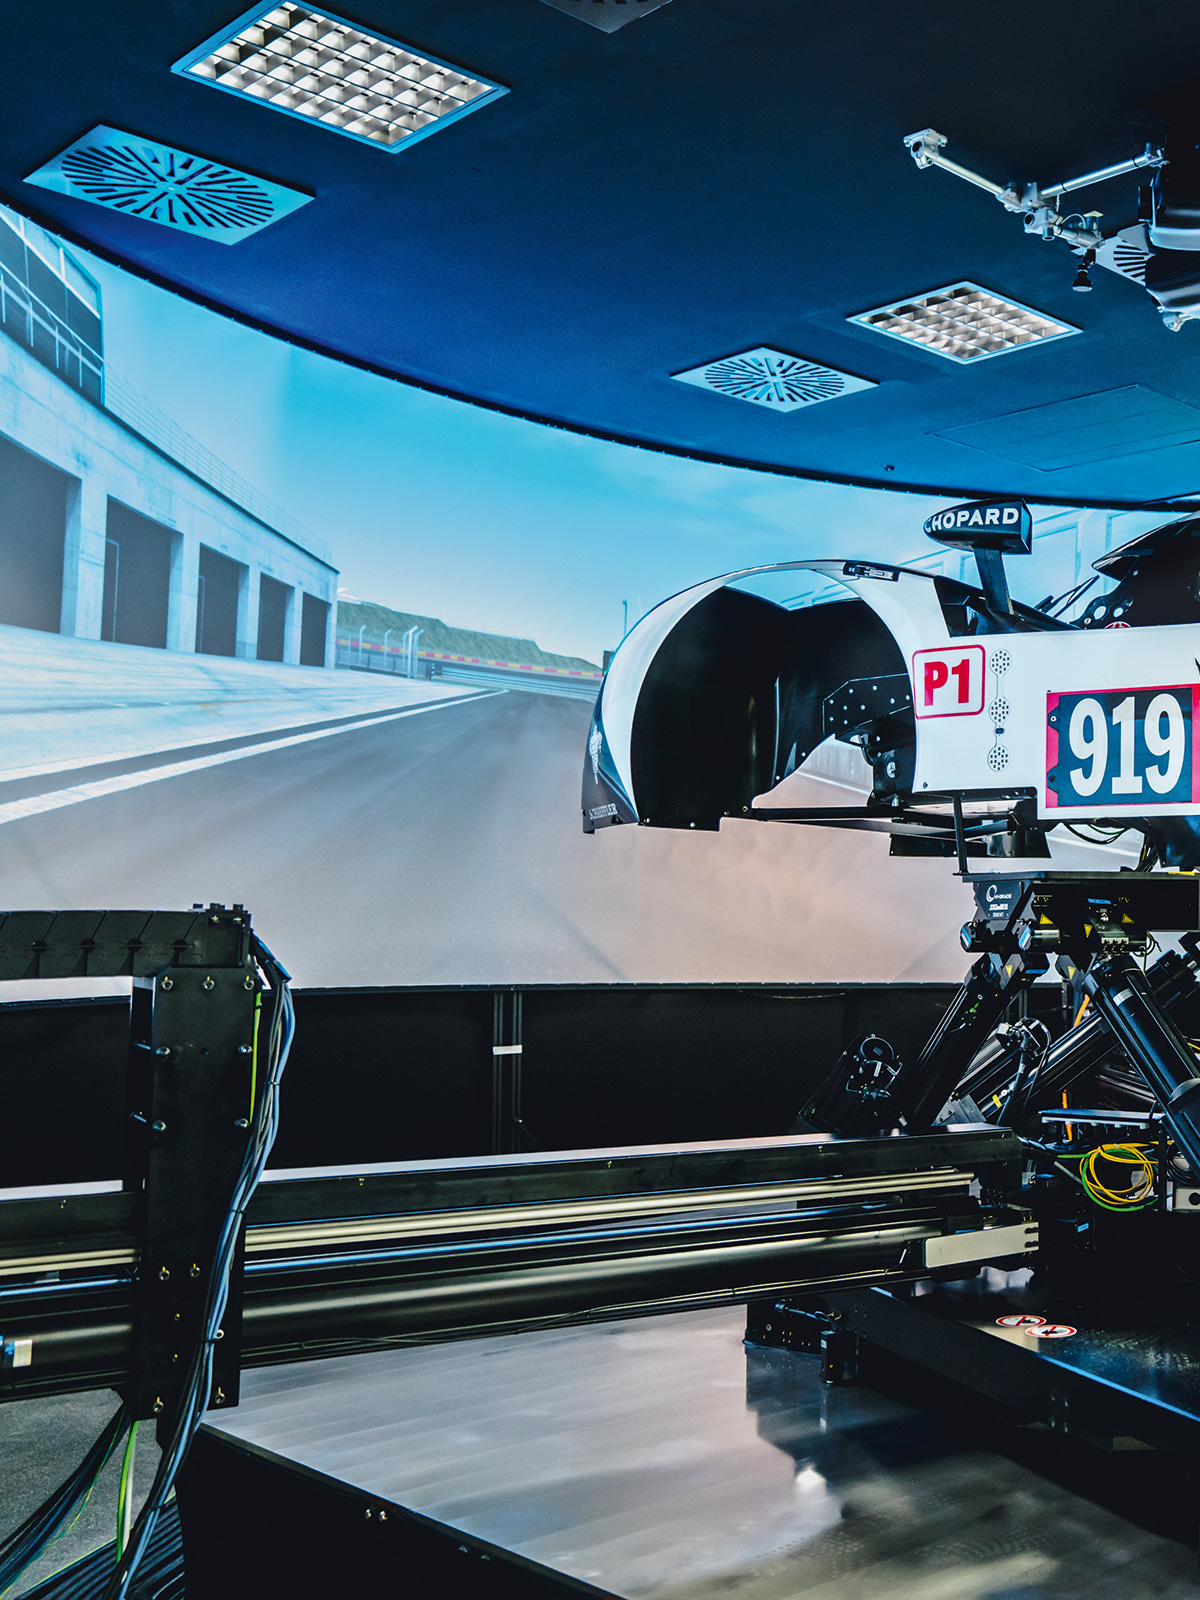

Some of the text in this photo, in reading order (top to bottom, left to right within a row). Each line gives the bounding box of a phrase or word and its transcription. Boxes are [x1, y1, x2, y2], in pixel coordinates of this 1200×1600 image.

[924, 507, 1019, 533] CHOPARD
[924, 658, 970, 706] P1
[1069, 693, 1185, 797] 919
